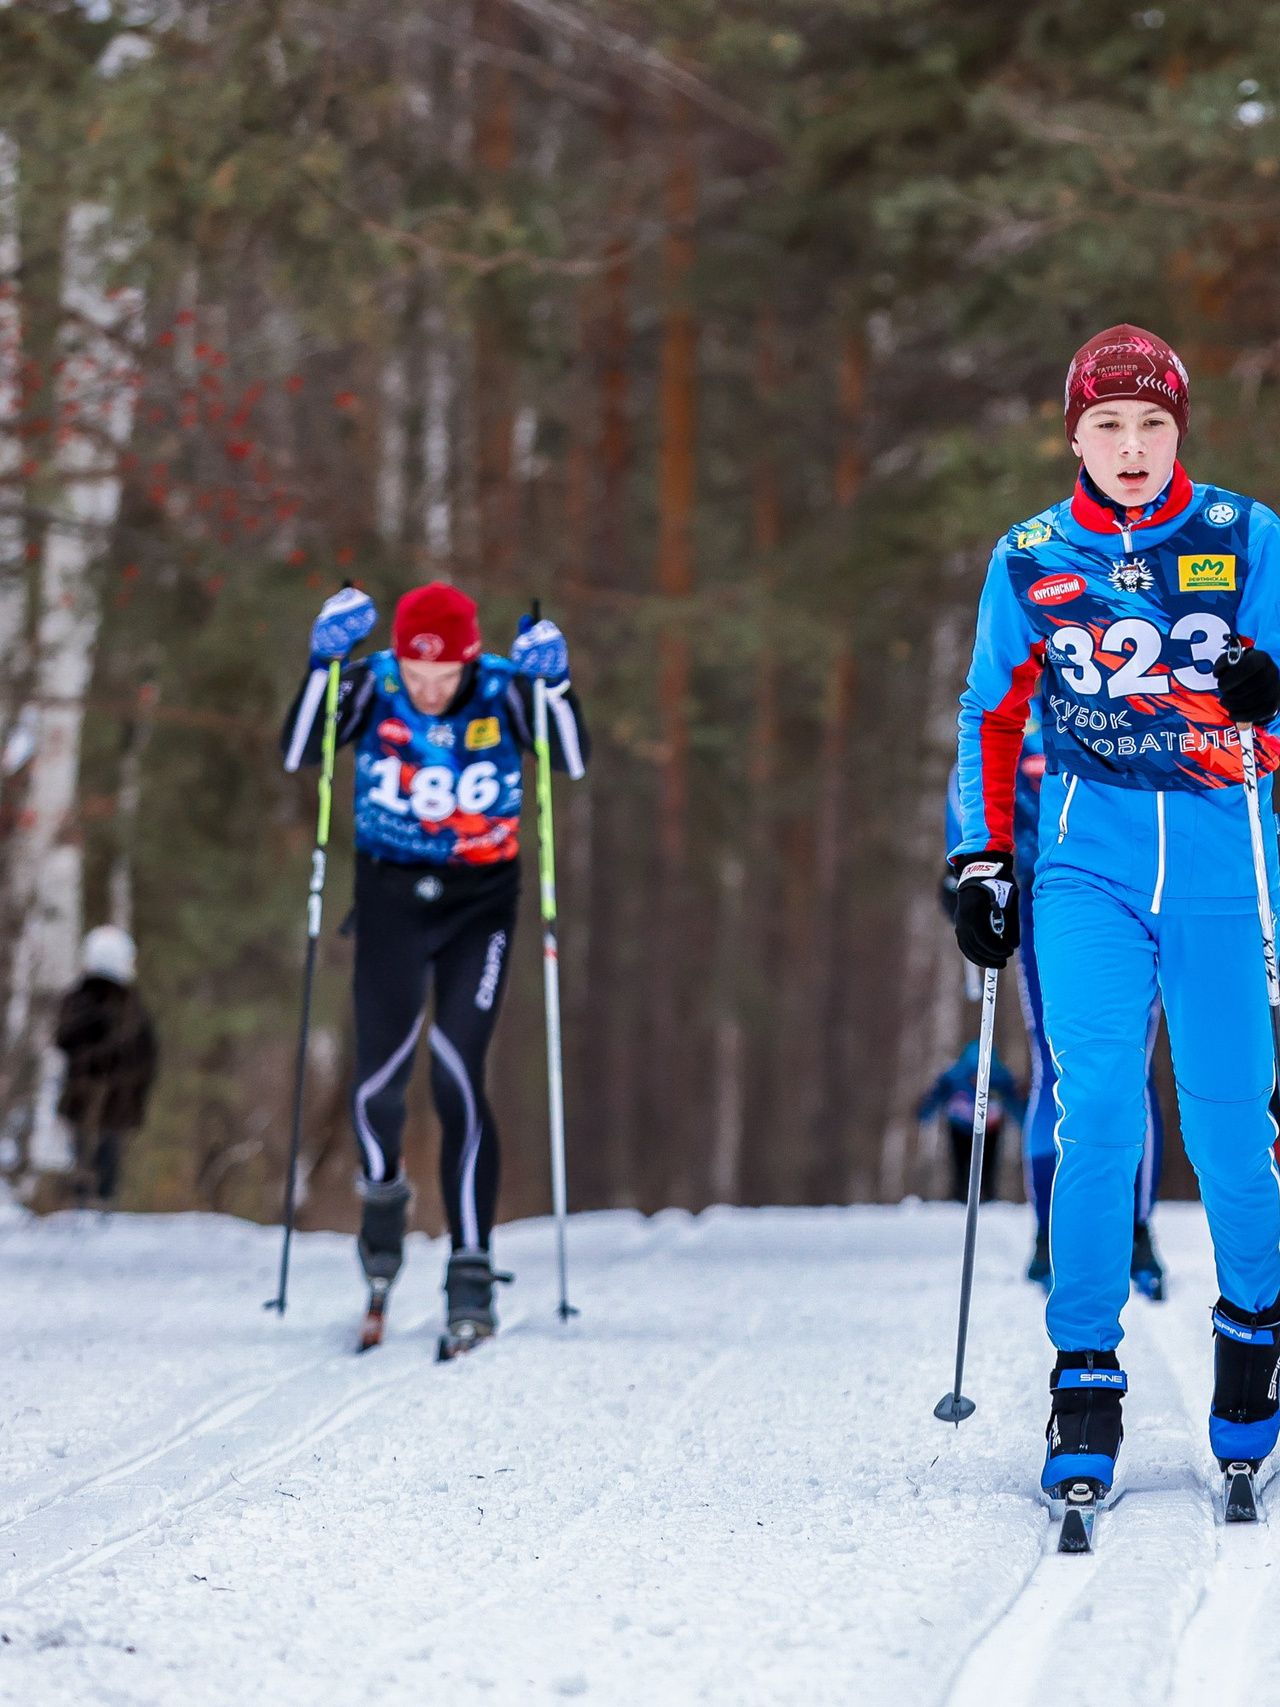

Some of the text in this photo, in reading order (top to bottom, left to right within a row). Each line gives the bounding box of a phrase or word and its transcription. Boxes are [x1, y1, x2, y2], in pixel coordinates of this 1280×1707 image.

[1096, 364, 1138, 375] ТАТИЩЕВ
[1033, 578, 1080, 600] КУРГАНСКИЙ
[1052, 612, 1232, 699] 323
[1050, 694, 1132, 731] КУБОК
[368, 755, 500, 822] 186
[1214, 1317, 1252, 1340] SPINE
[1080, 1374, 1122, 1383] SPINE
